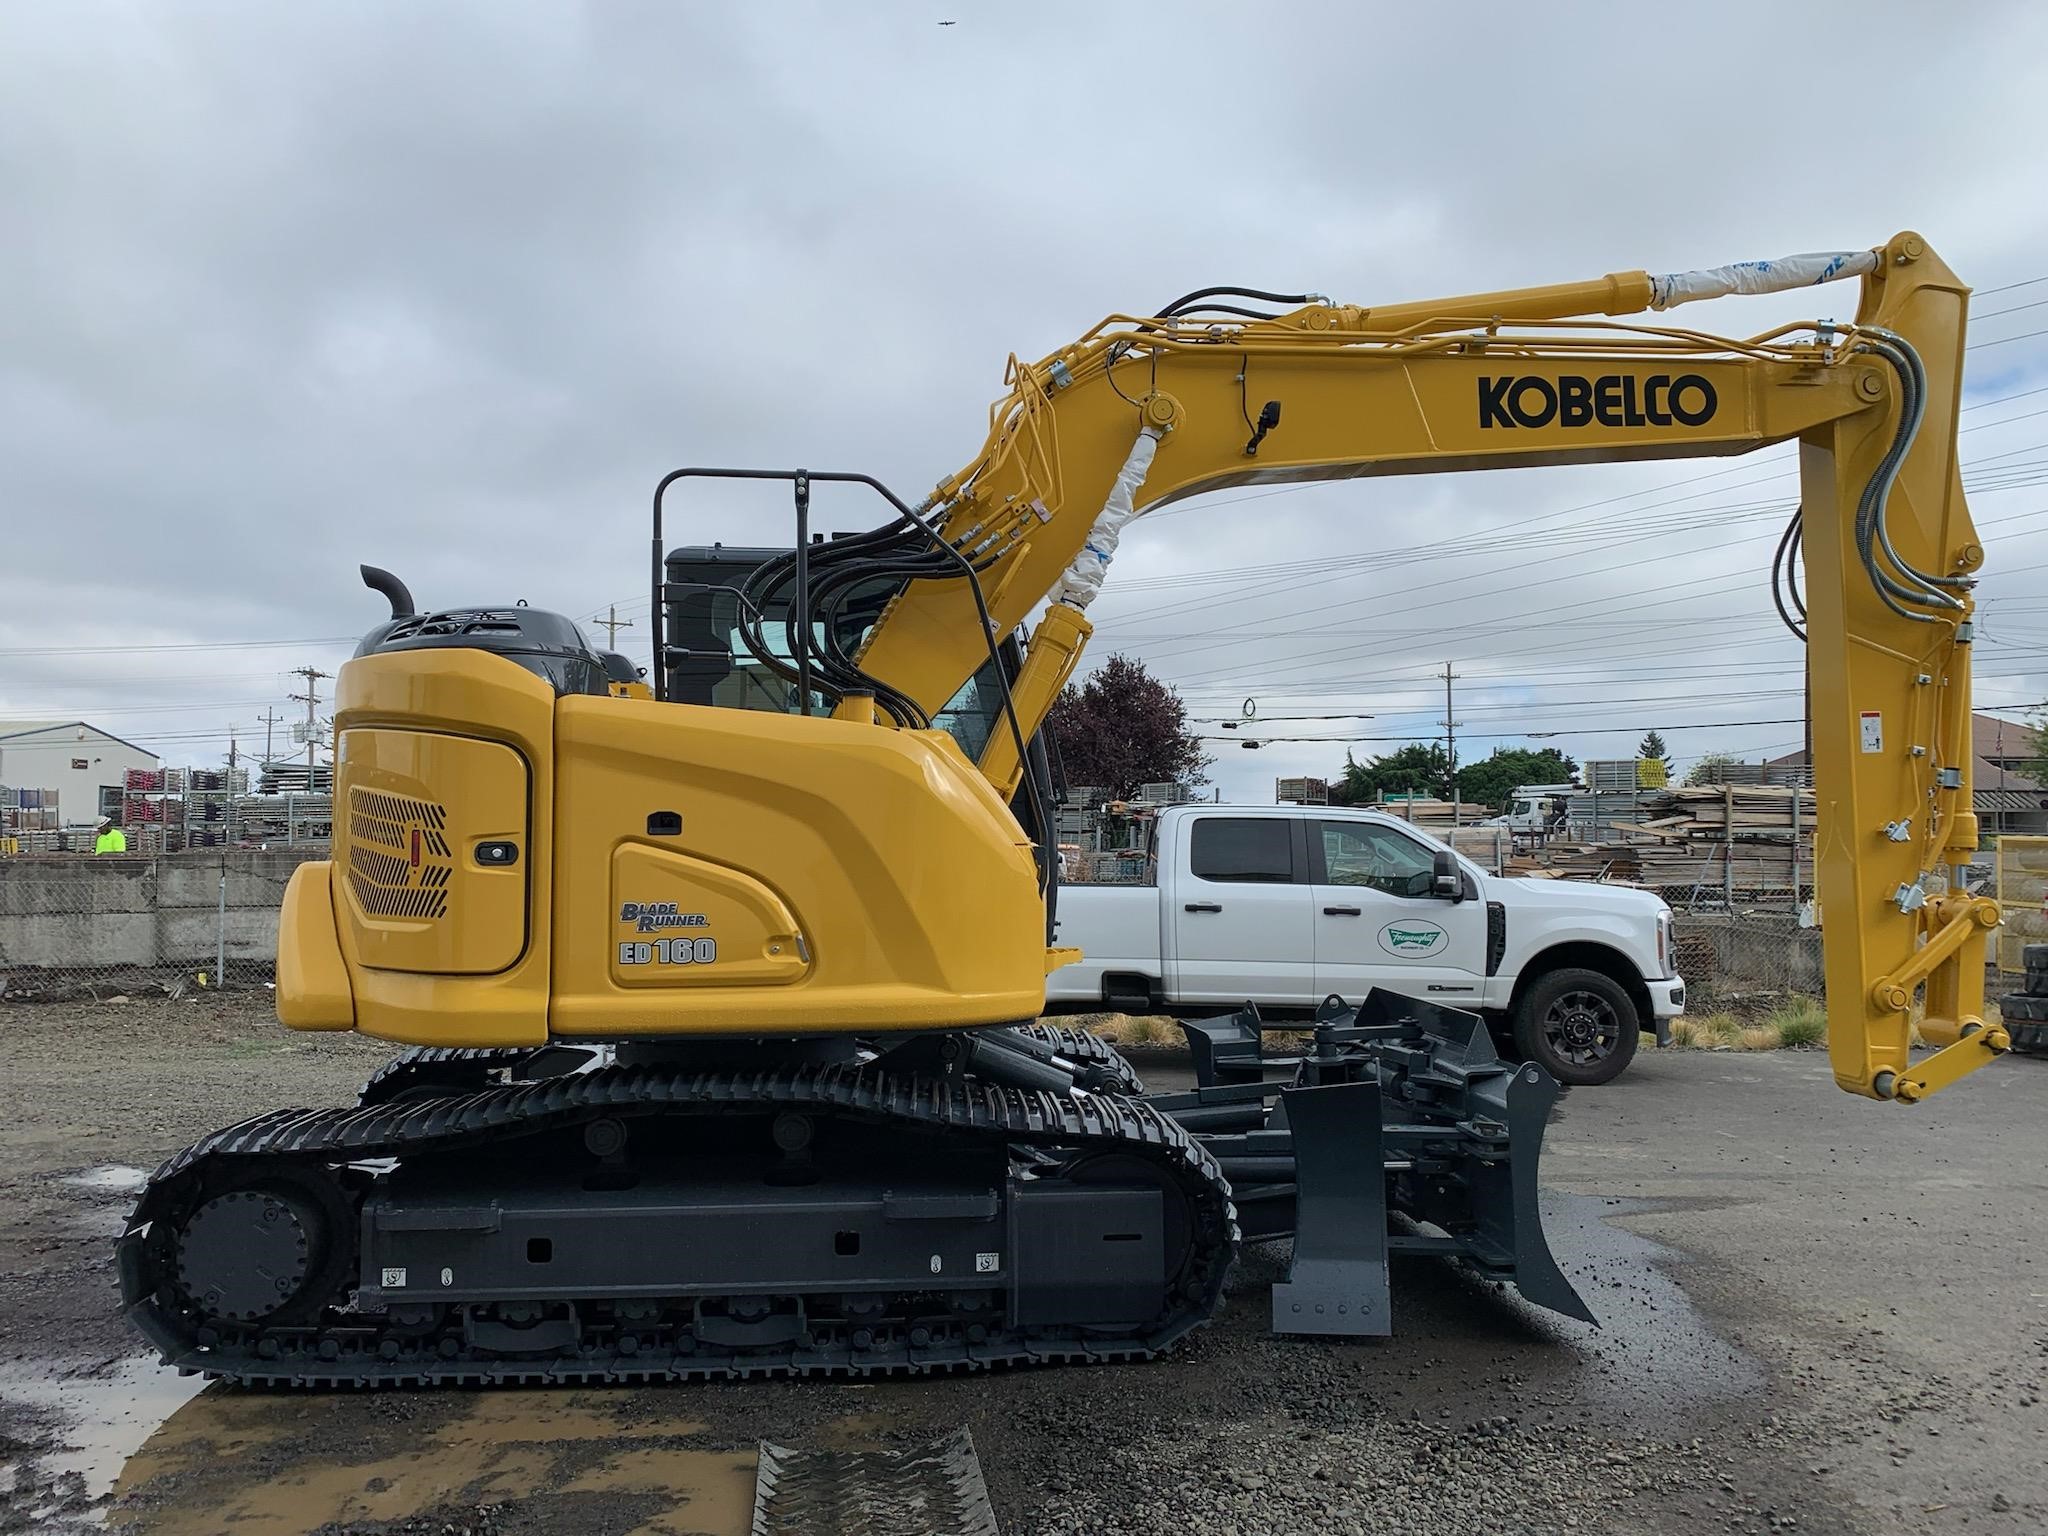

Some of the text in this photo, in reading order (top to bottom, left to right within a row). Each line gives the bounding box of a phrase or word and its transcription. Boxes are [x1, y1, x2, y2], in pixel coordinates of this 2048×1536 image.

[1478, 375, 1717, 428] KOBELCO
[621, 902, 678, 921] BLADE
[637, 914, 707, 932] RUNNER
